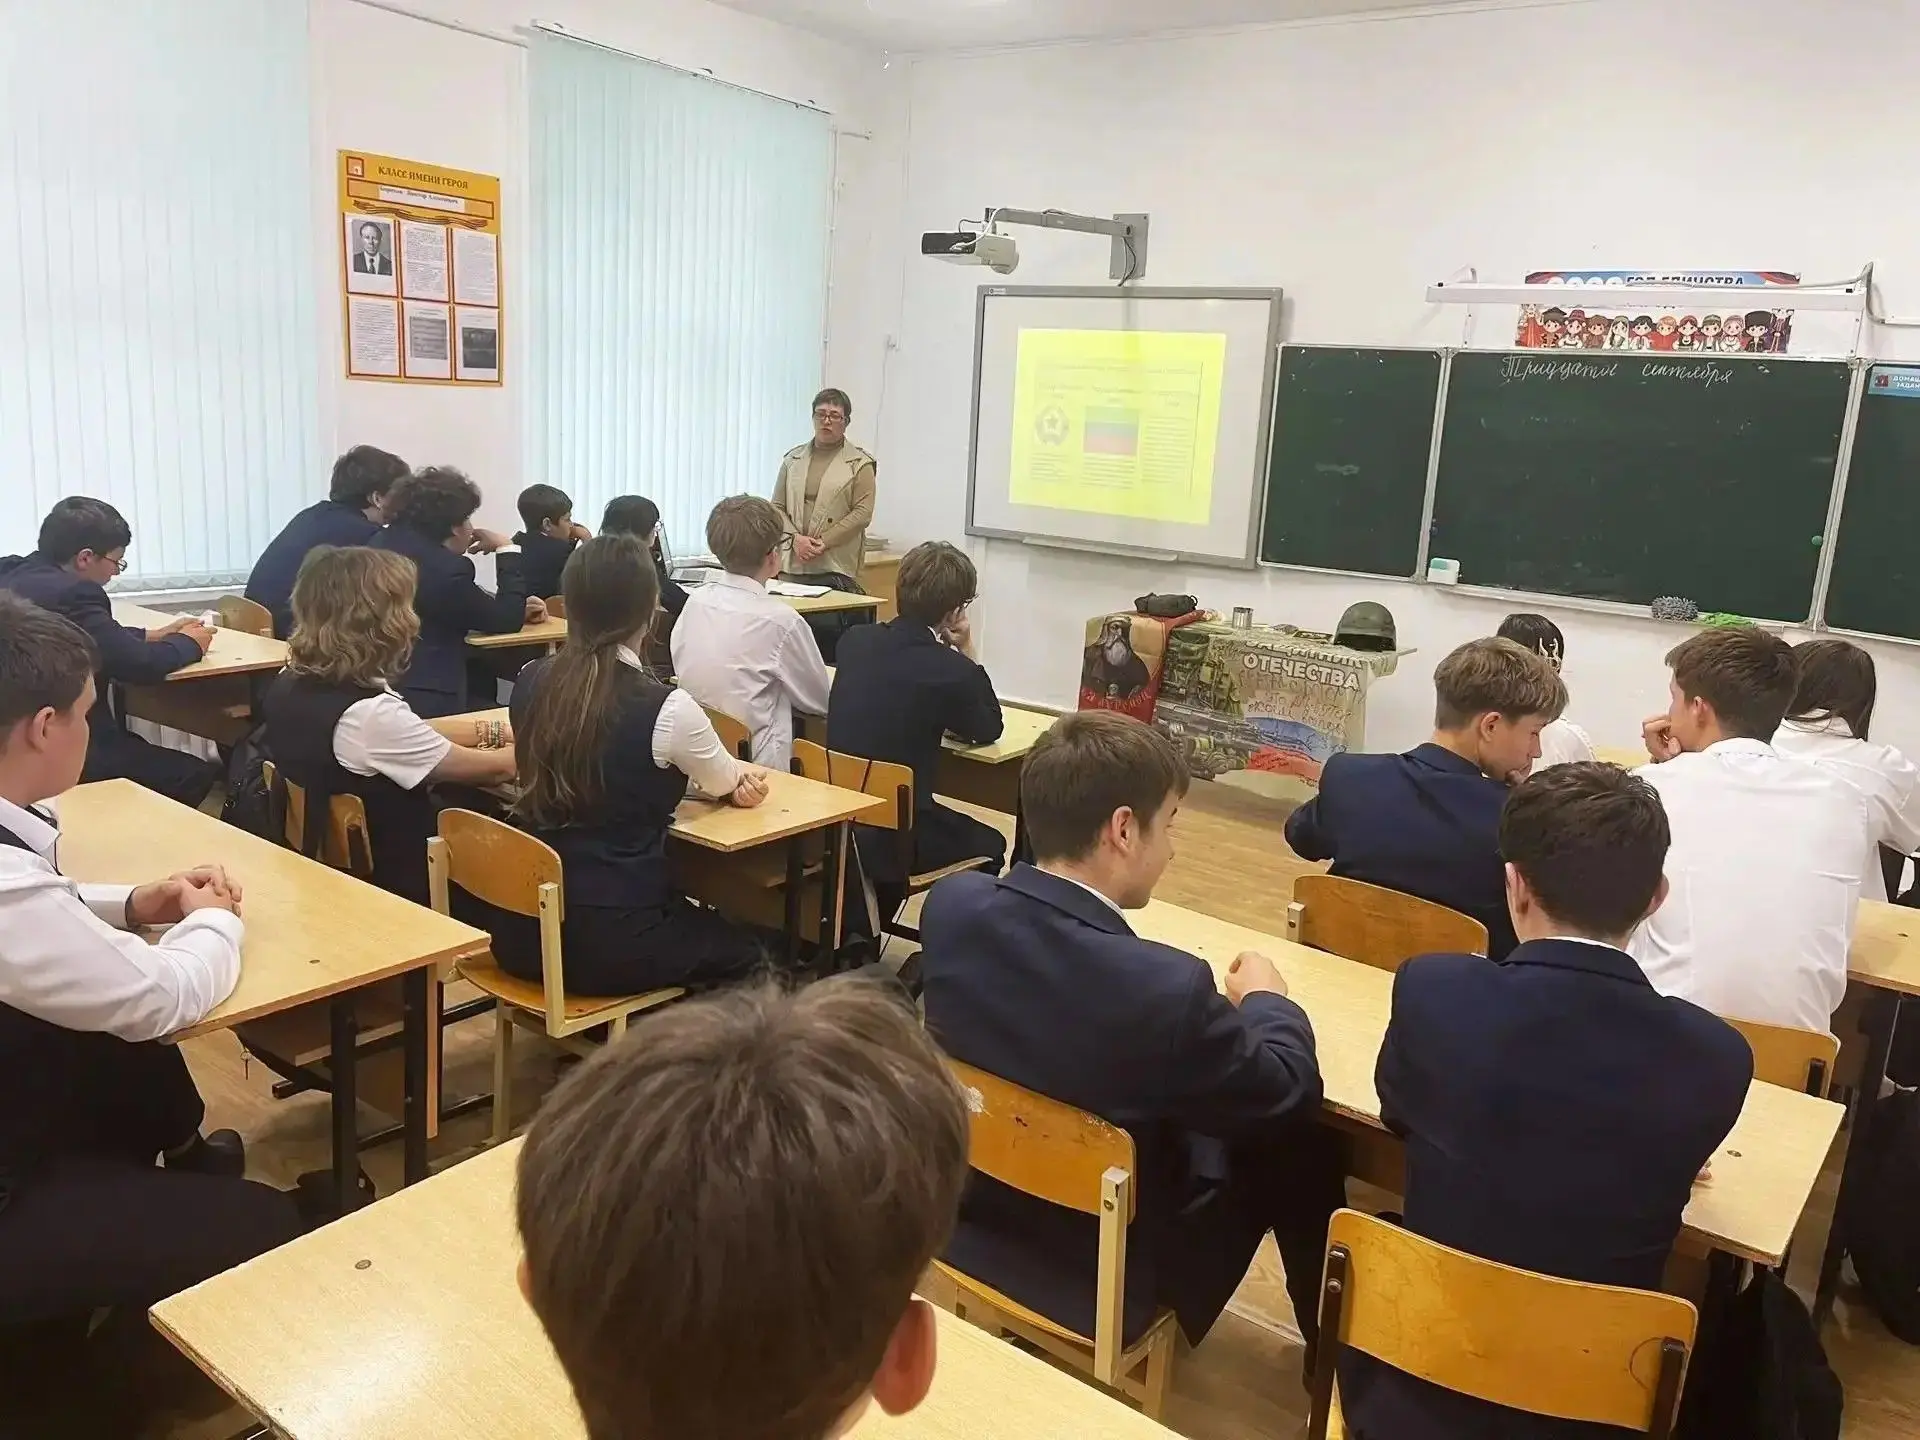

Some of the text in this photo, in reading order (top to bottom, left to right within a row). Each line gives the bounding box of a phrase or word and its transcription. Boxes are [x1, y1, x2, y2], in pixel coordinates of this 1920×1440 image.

[378, 165, 468, 190] КЛАСС ИМЕНИ ГЕРОЯ
[1642, 361, 1733, 387] сентября
[1243, 652, 1361, 692] ОТЕЧЕСТВА
